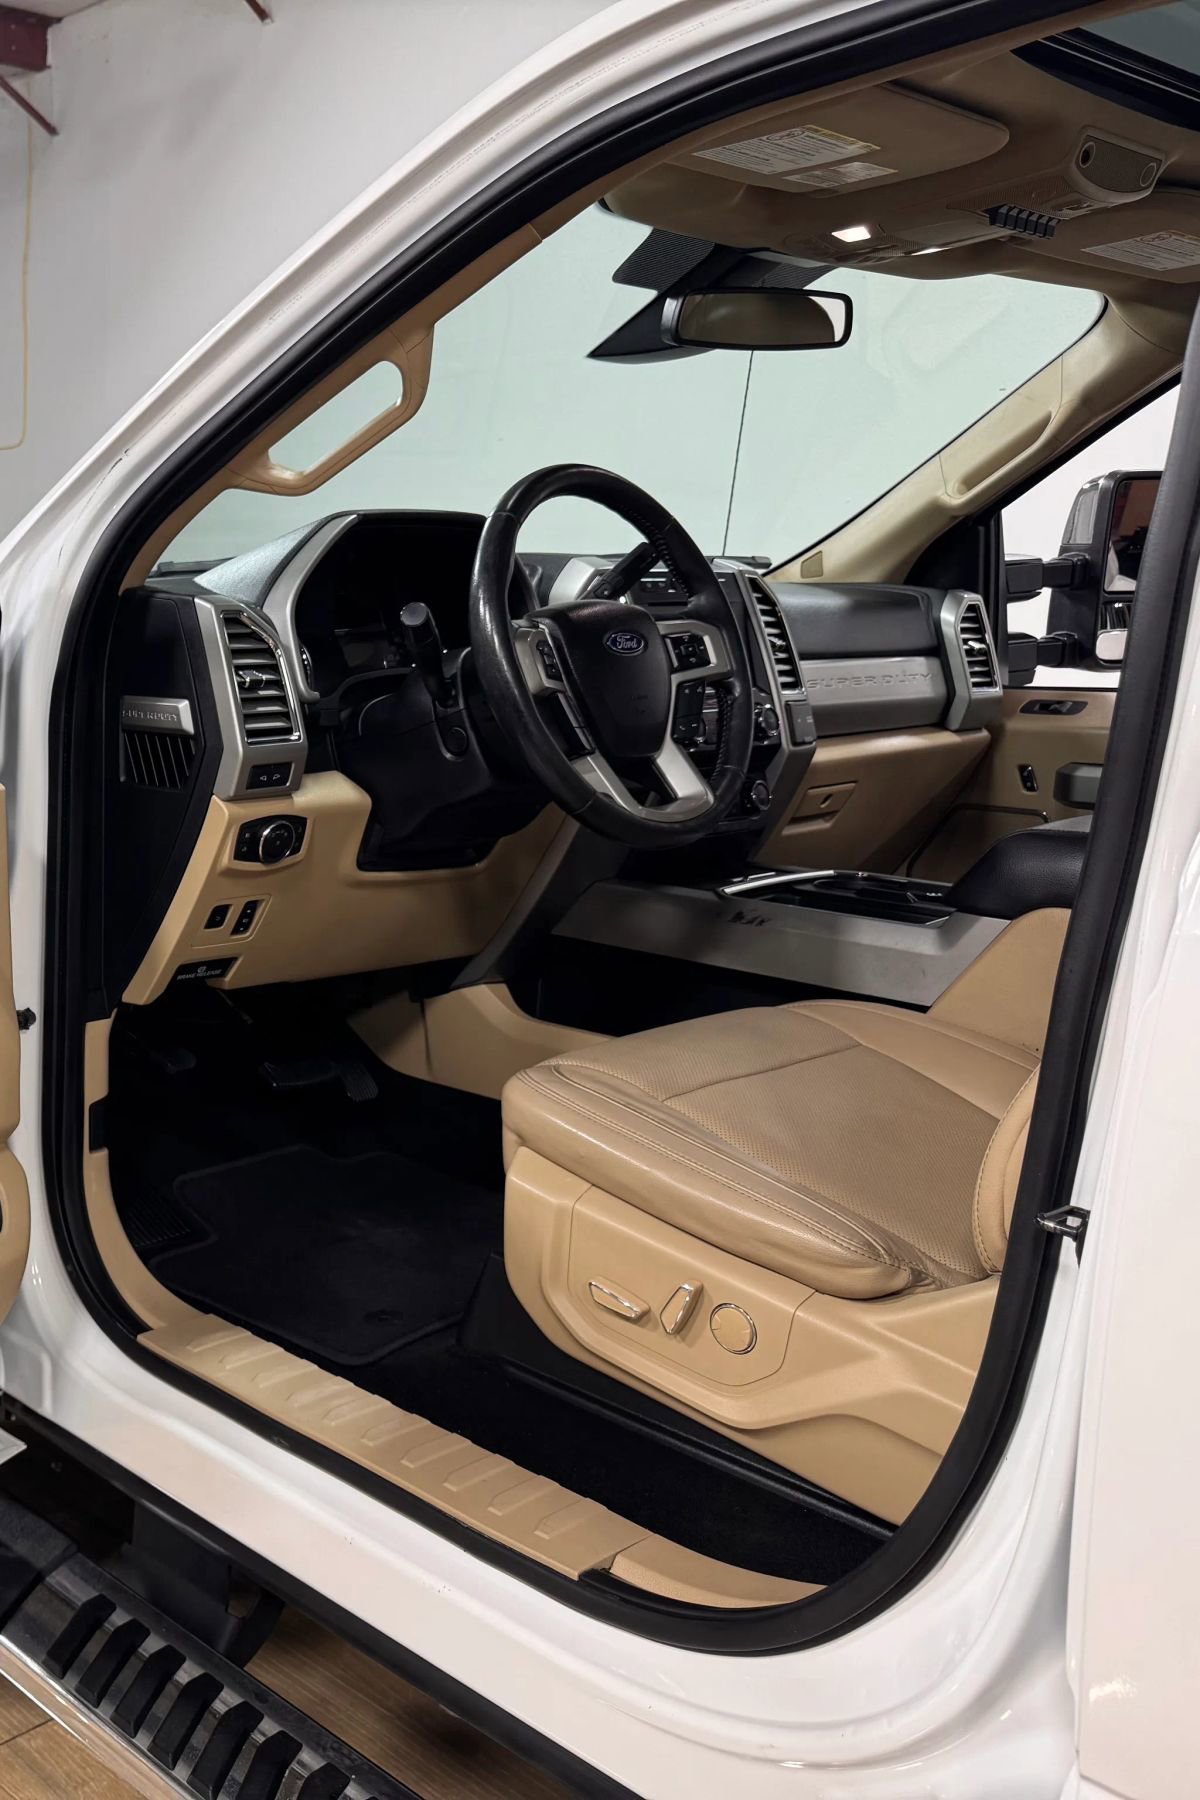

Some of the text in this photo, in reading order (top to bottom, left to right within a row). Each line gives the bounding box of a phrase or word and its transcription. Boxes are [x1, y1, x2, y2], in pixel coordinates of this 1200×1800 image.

[616, 634, 638, 649] Ford
[807, 672, 932, 689] SUPER DUTY
